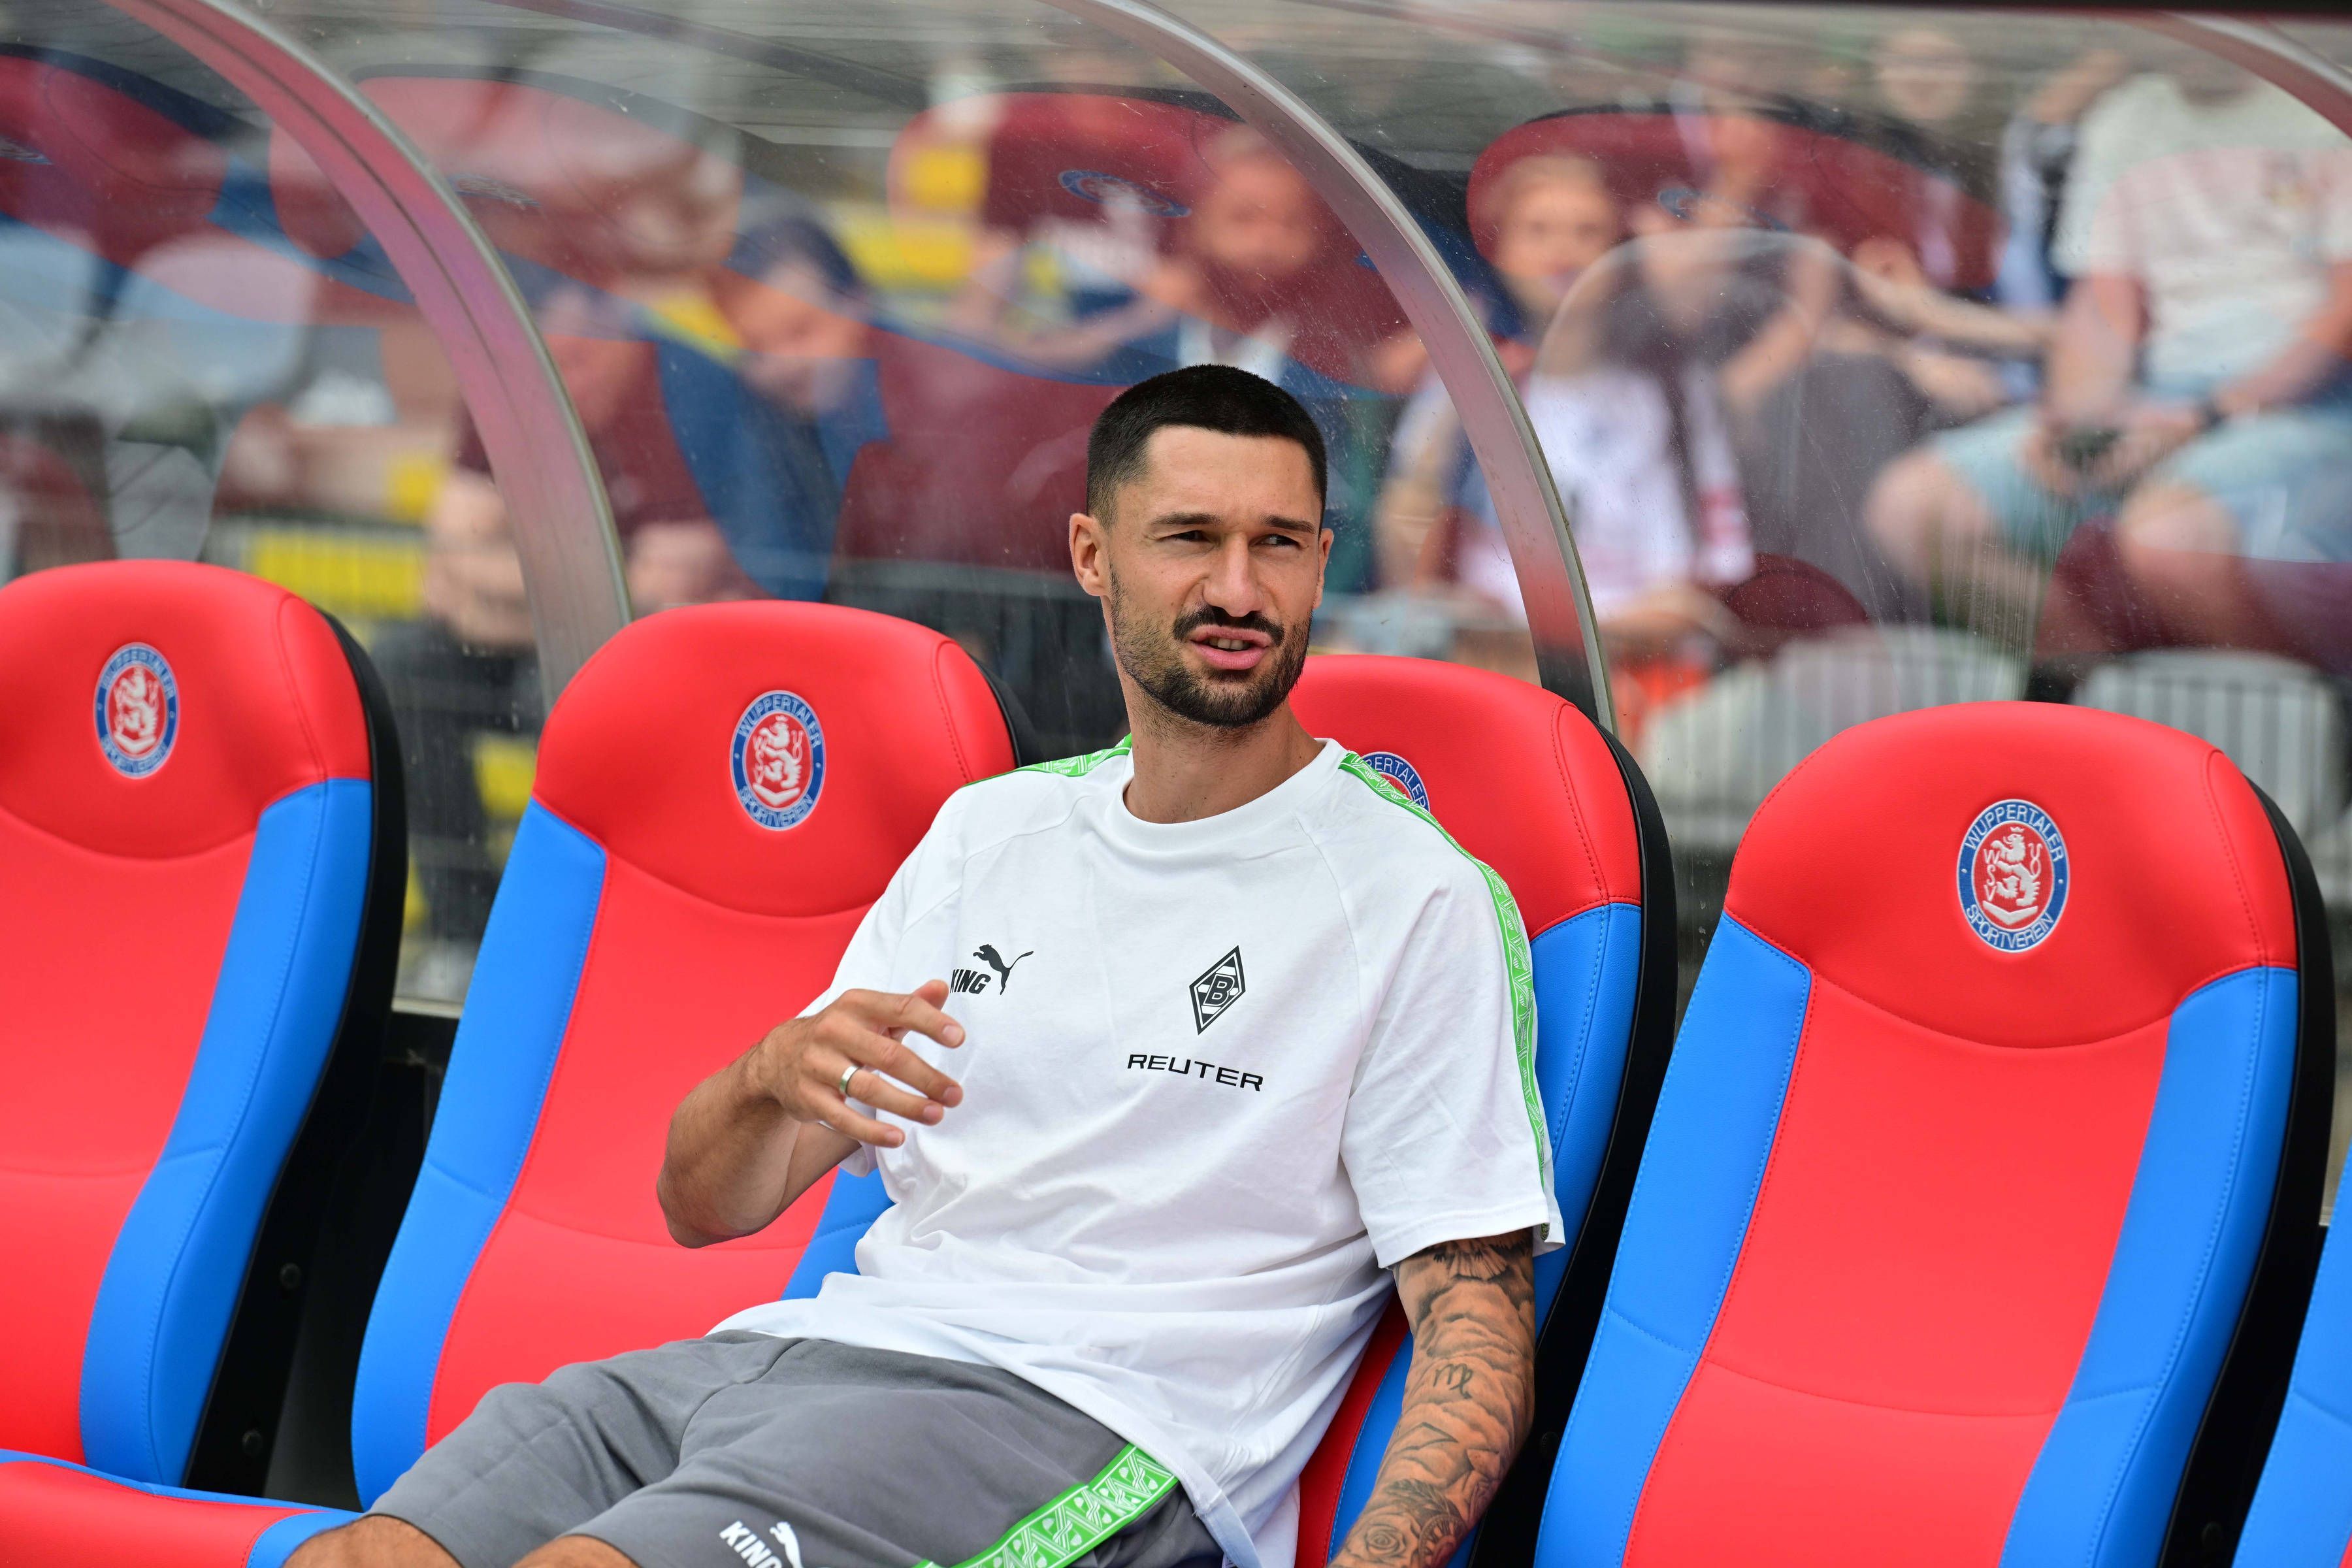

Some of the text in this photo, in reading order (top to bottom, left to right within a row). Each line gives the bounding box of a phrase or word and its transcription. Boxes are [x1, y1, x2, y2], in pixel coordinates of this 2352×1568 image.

[739, 694, 821, 749] WUPPERTALER
[1965, 804, 2064, 862] WUPPERTALER
[1966, 904, 2054, 949] SPORTVEREIN
[1127, 1054, 1264, 1092] REUTER
